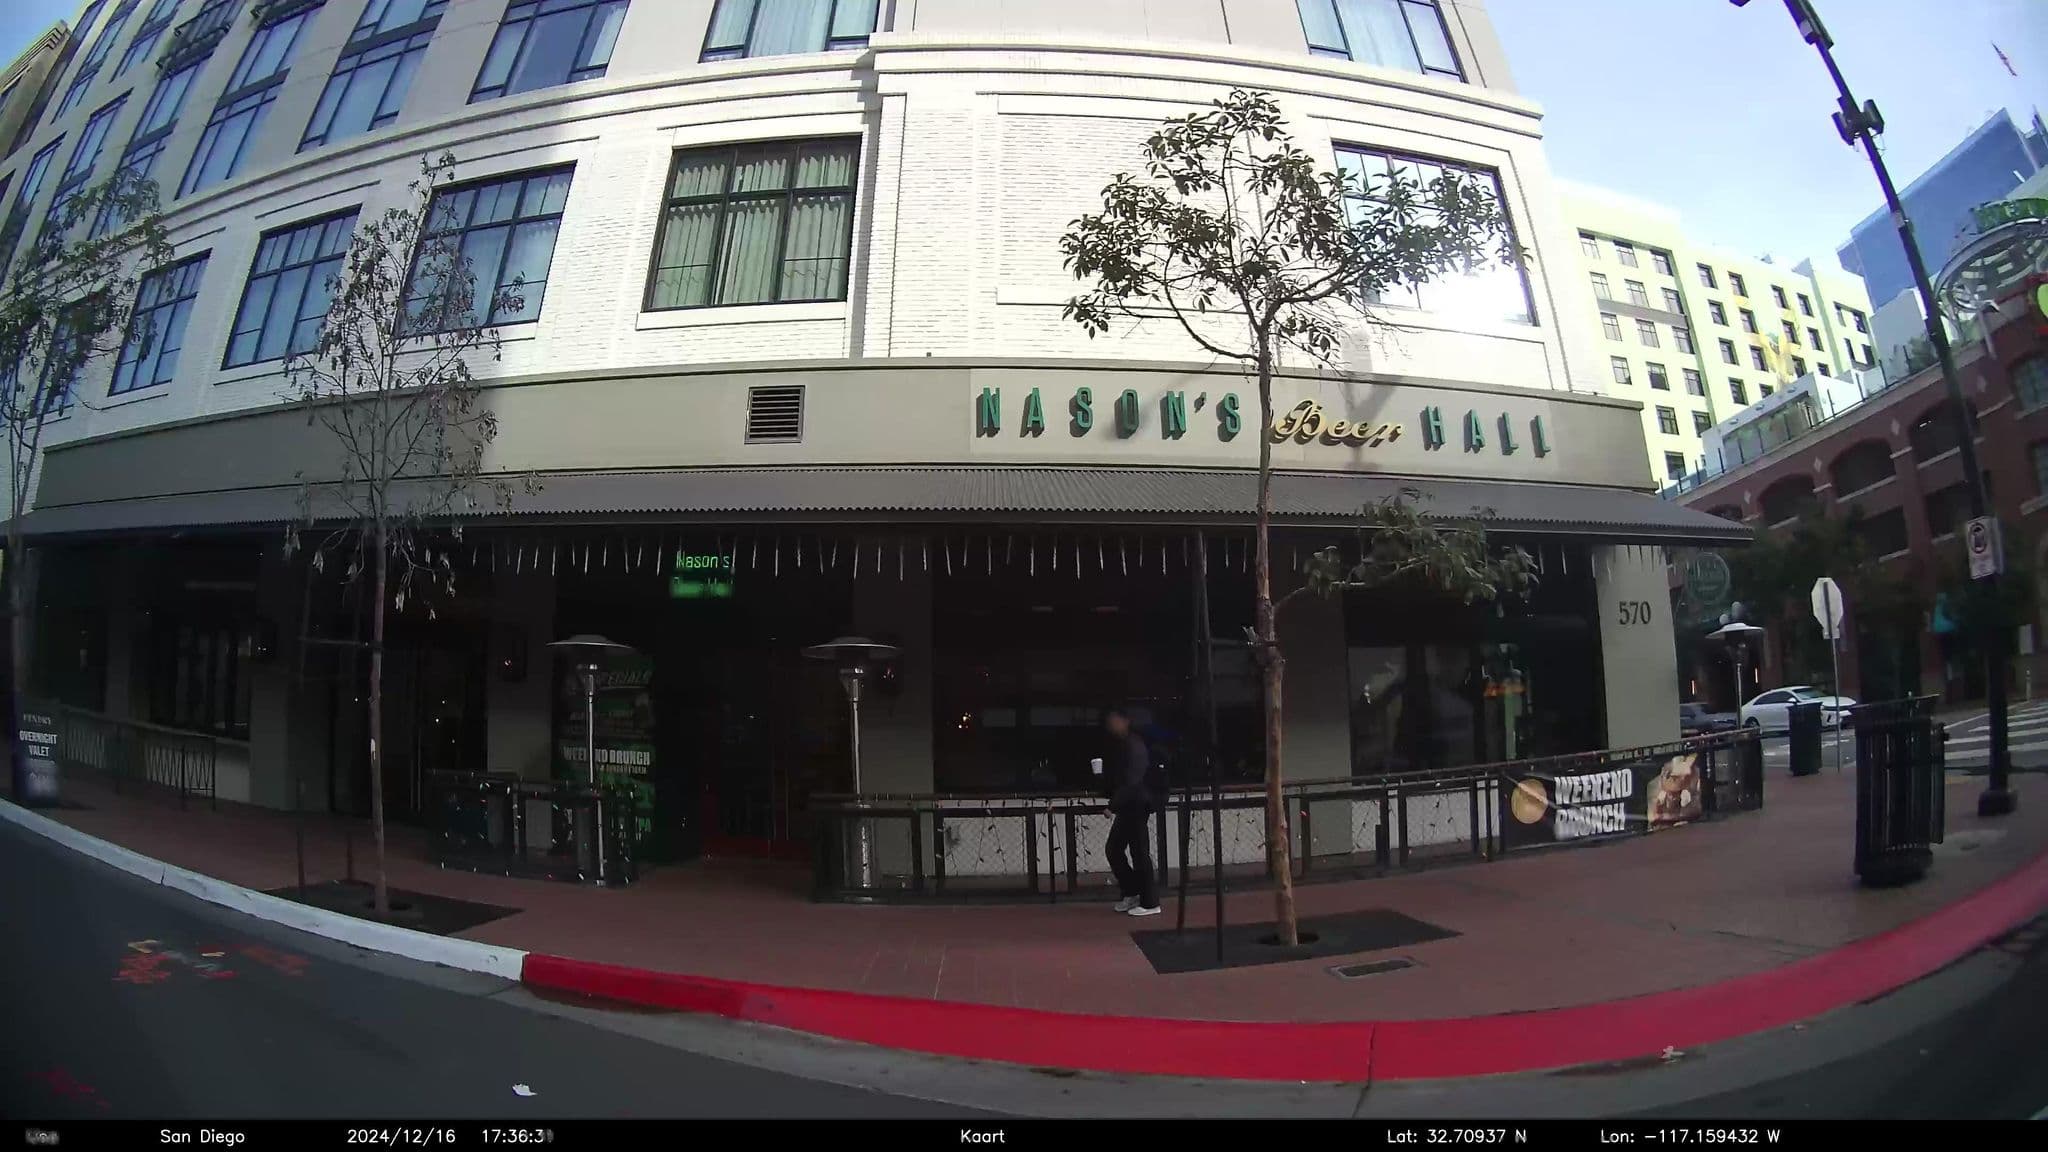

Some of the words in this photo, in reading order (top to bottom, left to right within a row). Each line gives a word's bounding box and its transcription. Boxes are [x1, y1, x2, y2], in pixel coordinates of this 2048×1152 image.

[978, 386, 1242, 440] NASON'S
[1272, 399, 1404, 444] Beer
[1421, 405, 1551, 456] HALL
[676, 550, 731, 569] Nasons
[1618, 601, 1652, 625] 570
[19, 730, 58, 745] OVERNIGHT
[28, 745, 50, 757] VALET
[562, 746, 608, 764] WEEND
[1554, 768, 1632, 805] WEEKEND
